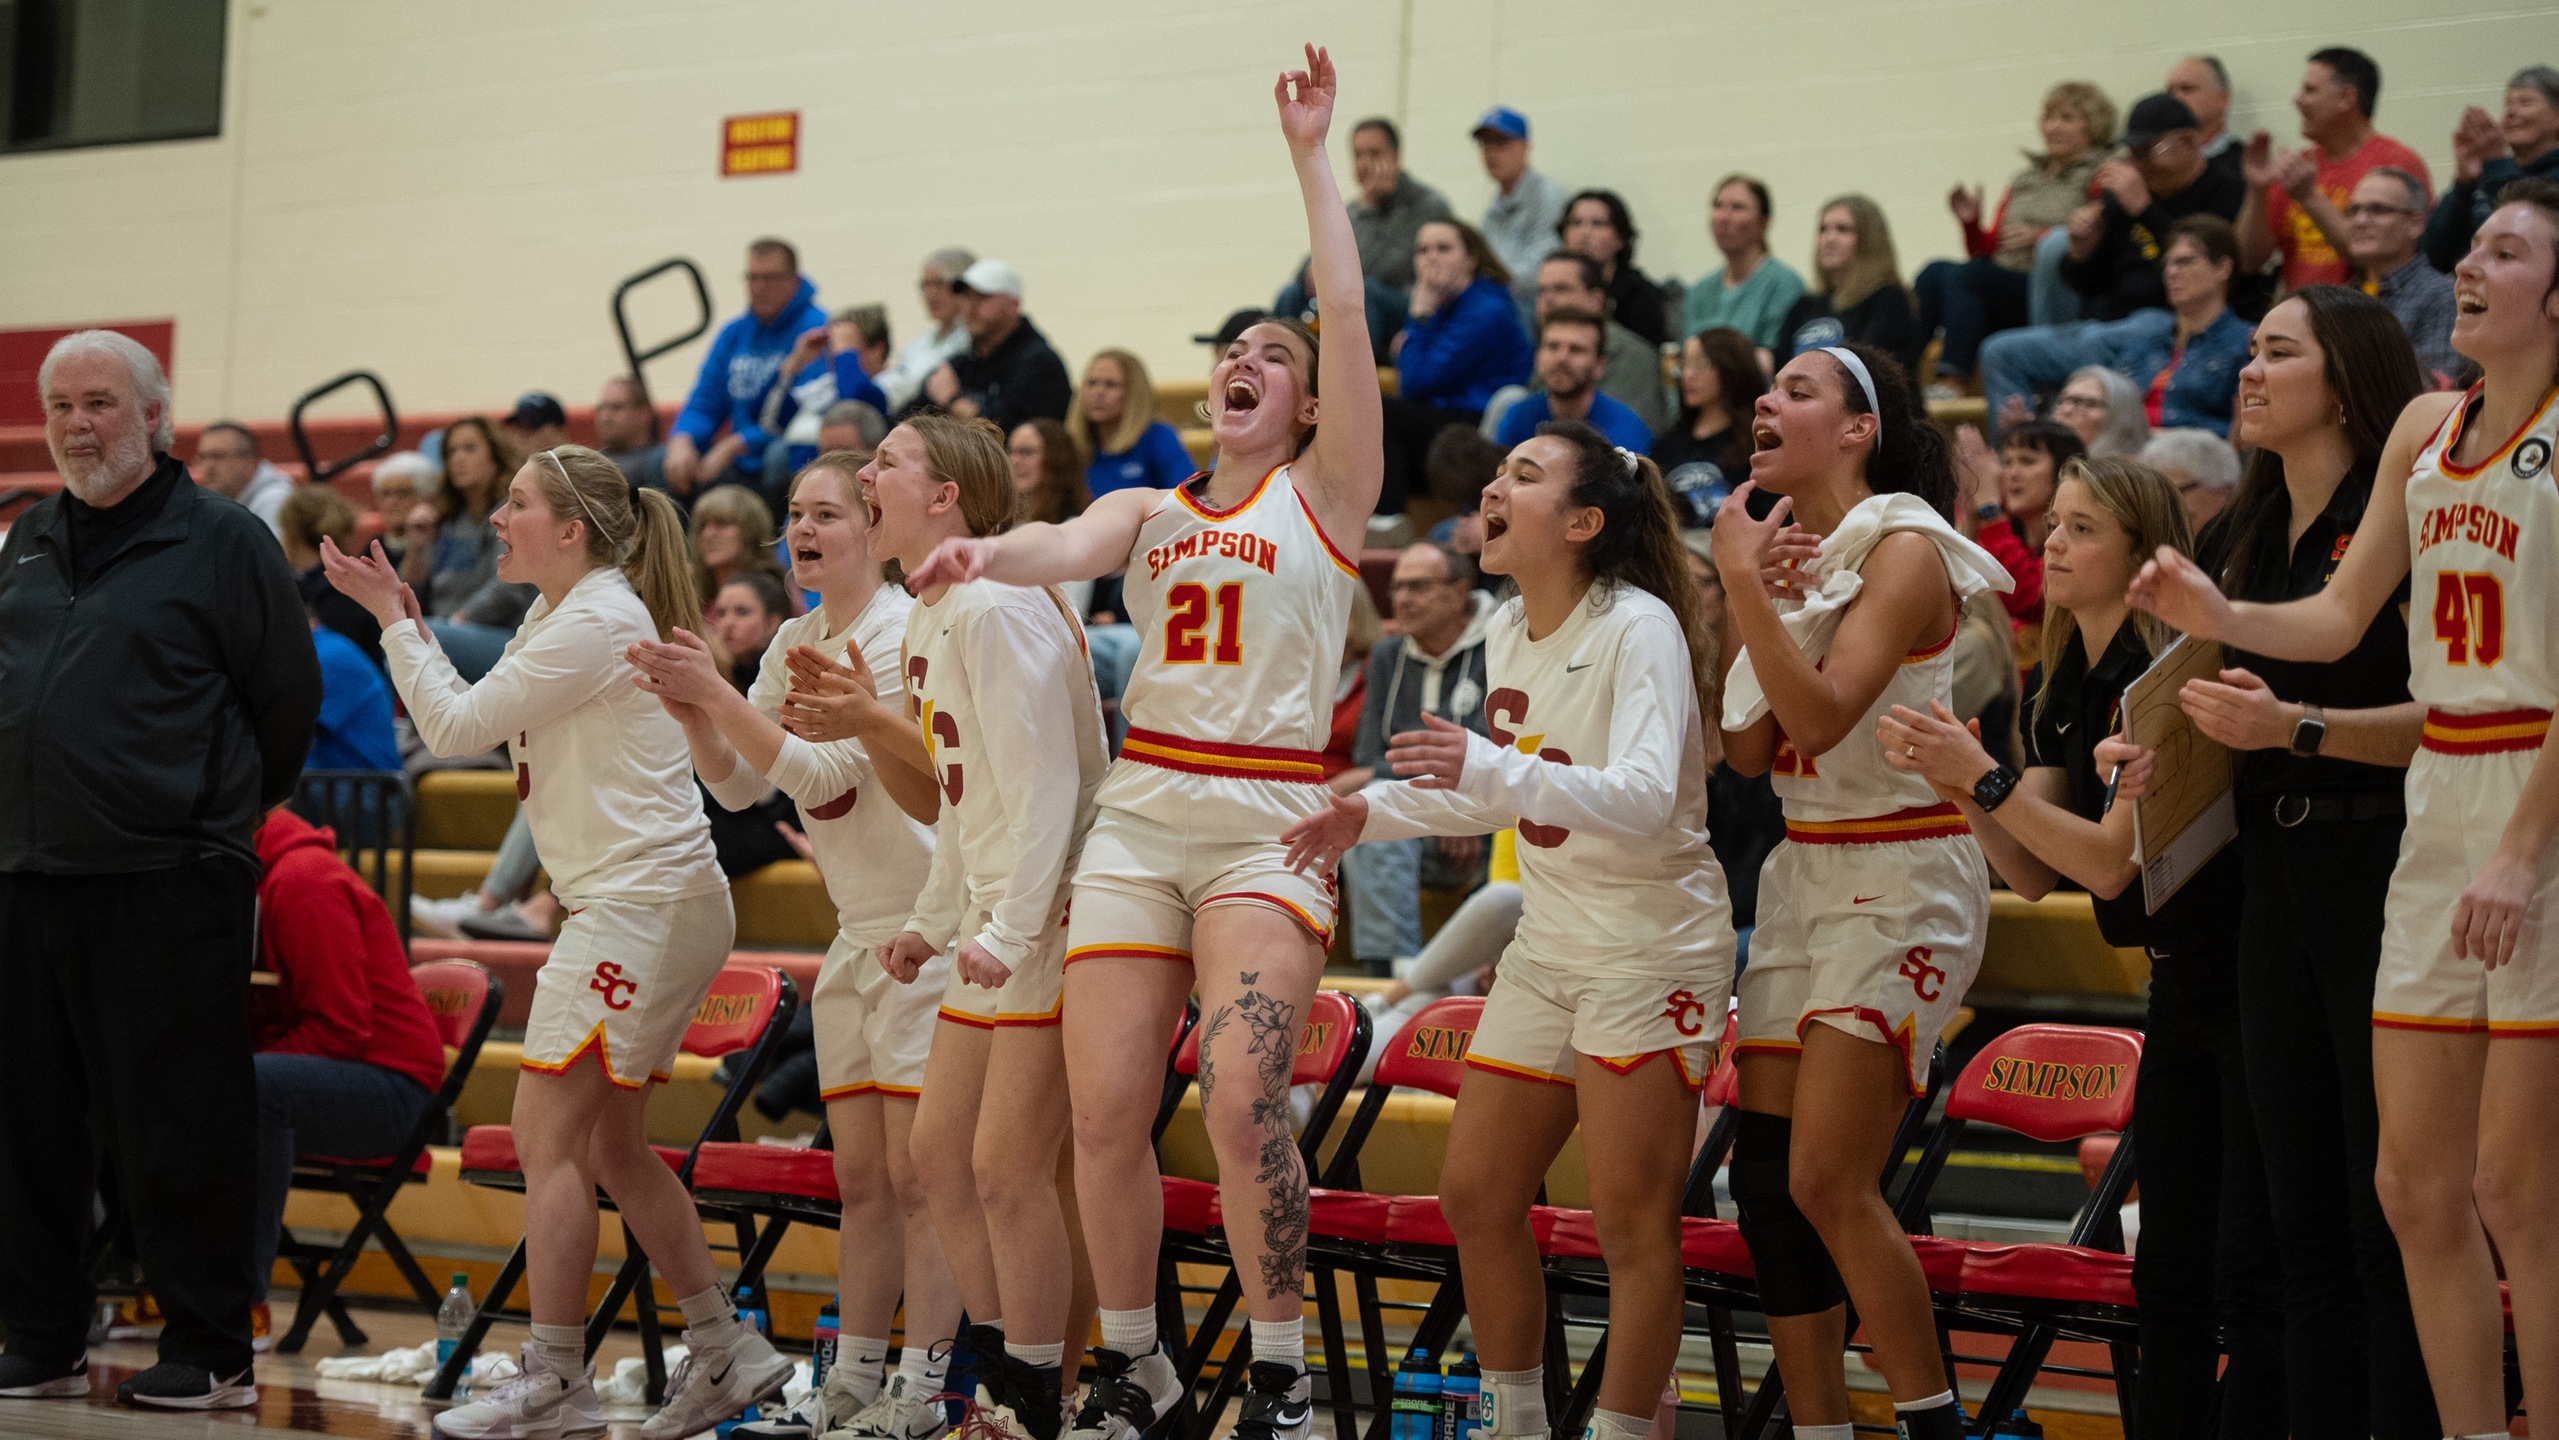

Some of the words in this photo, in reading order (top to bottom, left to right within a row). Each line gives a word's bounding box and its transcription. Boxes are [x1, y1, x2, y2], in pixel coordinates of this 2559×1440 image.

[1147, 530, 1278, 582] SIMPSON
[2418, 503, 2520, 564] SIMPSON
[1163, 582, 1244, 666] 21
[2432, 570, 2505, 668] 40
[589, 961, 637, 1013] SC
[1898, 946, 1946, 1005] SC
[1663, 989, 1705, 1038] SC
[1983, 1056, 2127, 1100] SIMPSON
